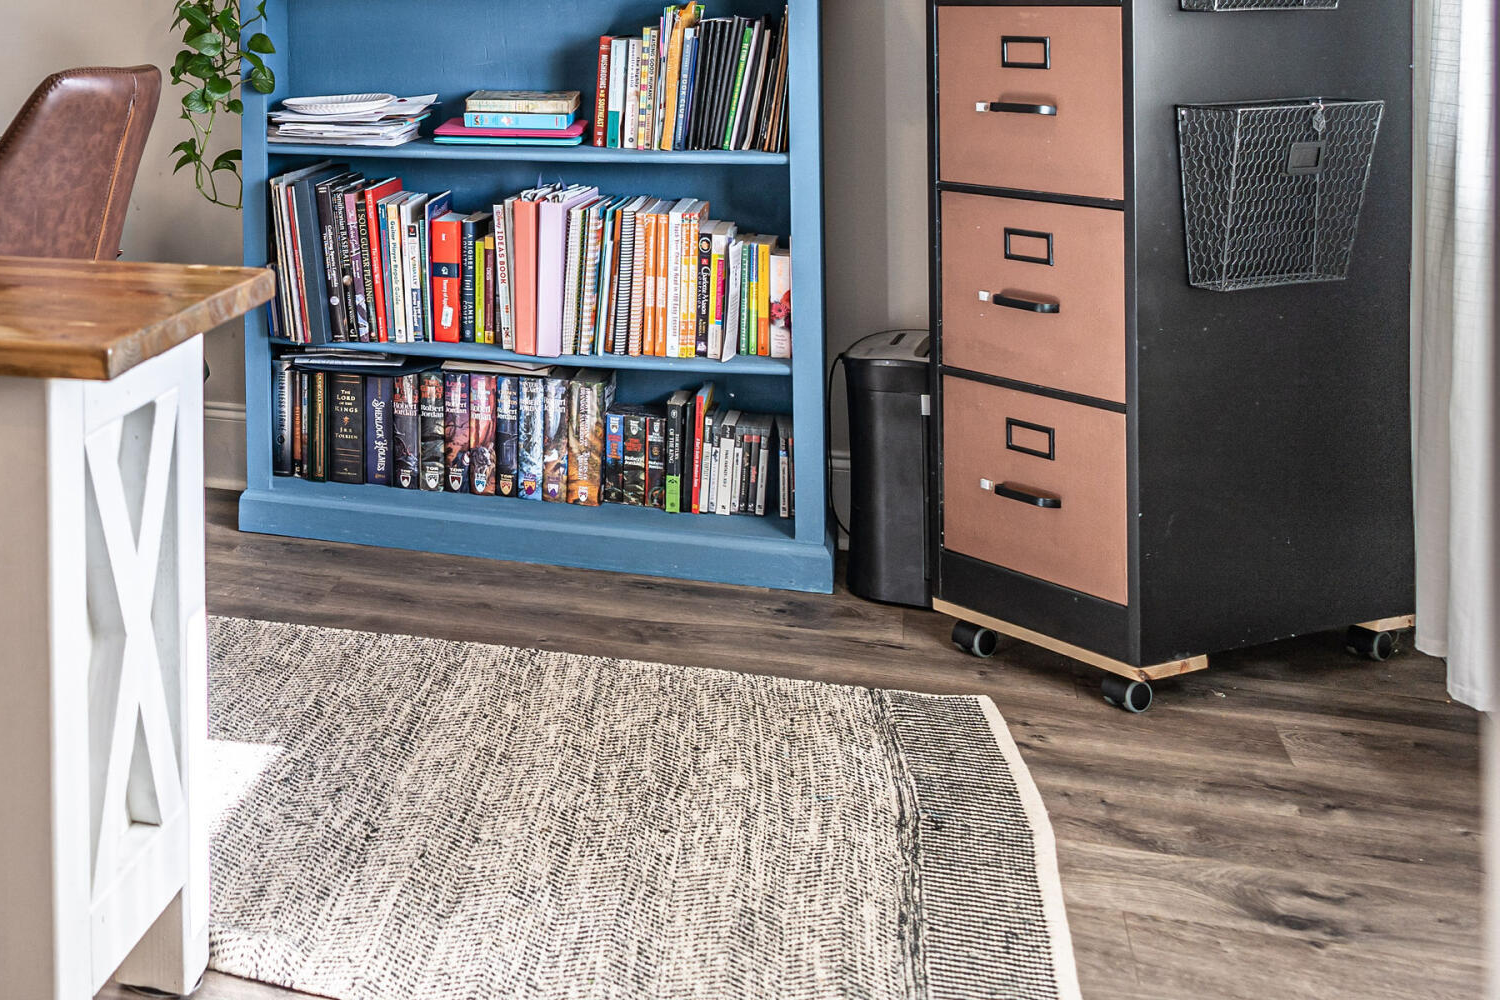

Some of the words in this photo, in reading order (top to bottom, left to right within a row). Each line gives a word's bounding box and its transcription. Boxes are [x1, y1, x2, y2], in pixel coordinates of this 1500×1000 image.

[600, 55, 608, 88] MUSHROOMS
[597, 98, 605, 127] SOUTHEAST
[336, 193, 345, 230] Smithsonian
[358, 213, 366, 235] SOLO
[327, 225, 335, 249] Collecting
[338, 231, 350, 268] BASEBALL
[496, 230, 505, 258] IDEAS
[360, 237, 370, 267] GUITAR
[466, 241, 474, 270] HIGHER
[361, 269, 373, 303] PLAYING
[392, 265, 400, 285] Repair
[499, 260, 507, 285] BOOK
[701, 266, 711, 294] Charlotte
[278, 371, 286, 408] RELENTLESS
[278, 410, 286, 431] STRIKE
[669, 428, 674, 436] OF
